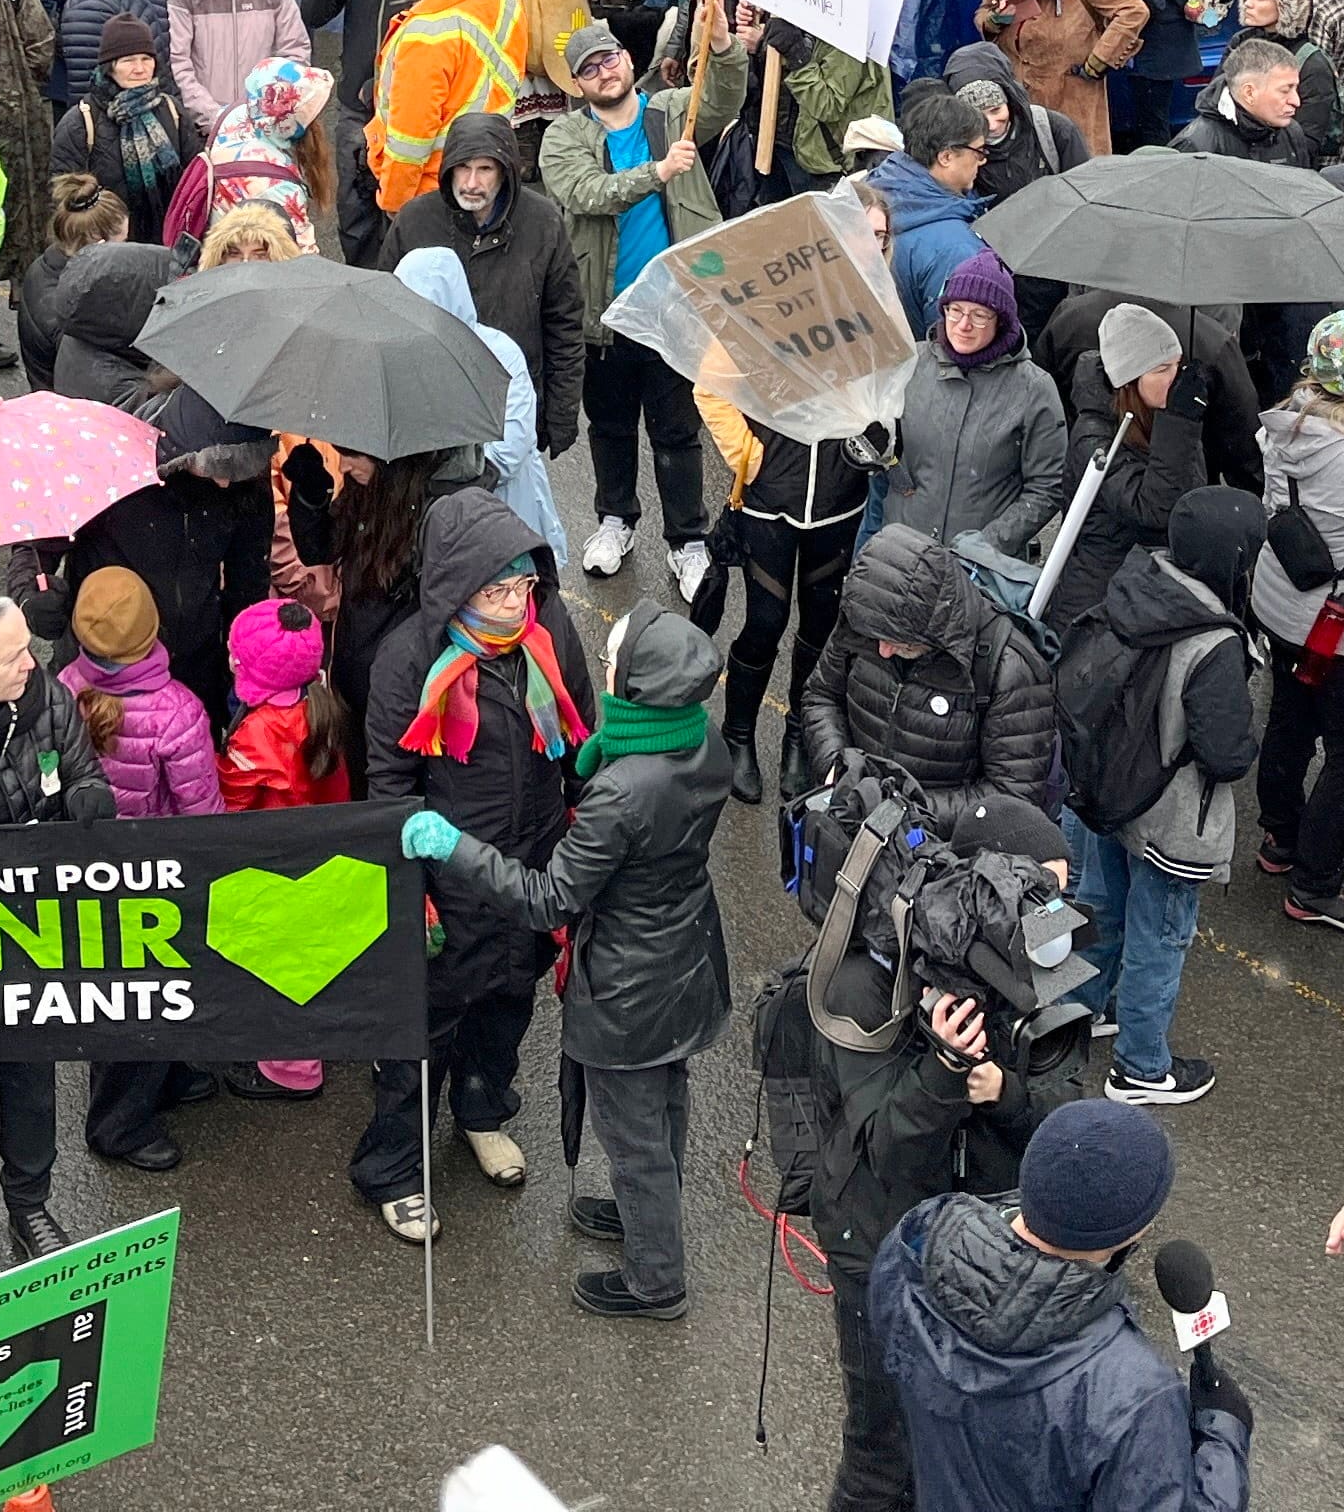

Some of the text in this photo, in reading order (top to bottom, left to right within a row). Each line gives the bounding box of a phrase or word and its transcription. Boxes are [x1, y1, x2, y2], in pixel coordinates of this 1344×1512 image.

[720, 238, 840, 306] LE BAPE
[776, 289, 816, 318] DIT
[56, 859, 186, 891] POUR
[86, 1250, 118, 1271] de
[125, 1230, 170, 1258] nos
[69, 1255, 167, 1302] enfants
[72, 1311, 94, 1343] au
[63, 1381, 94, 1436] front
